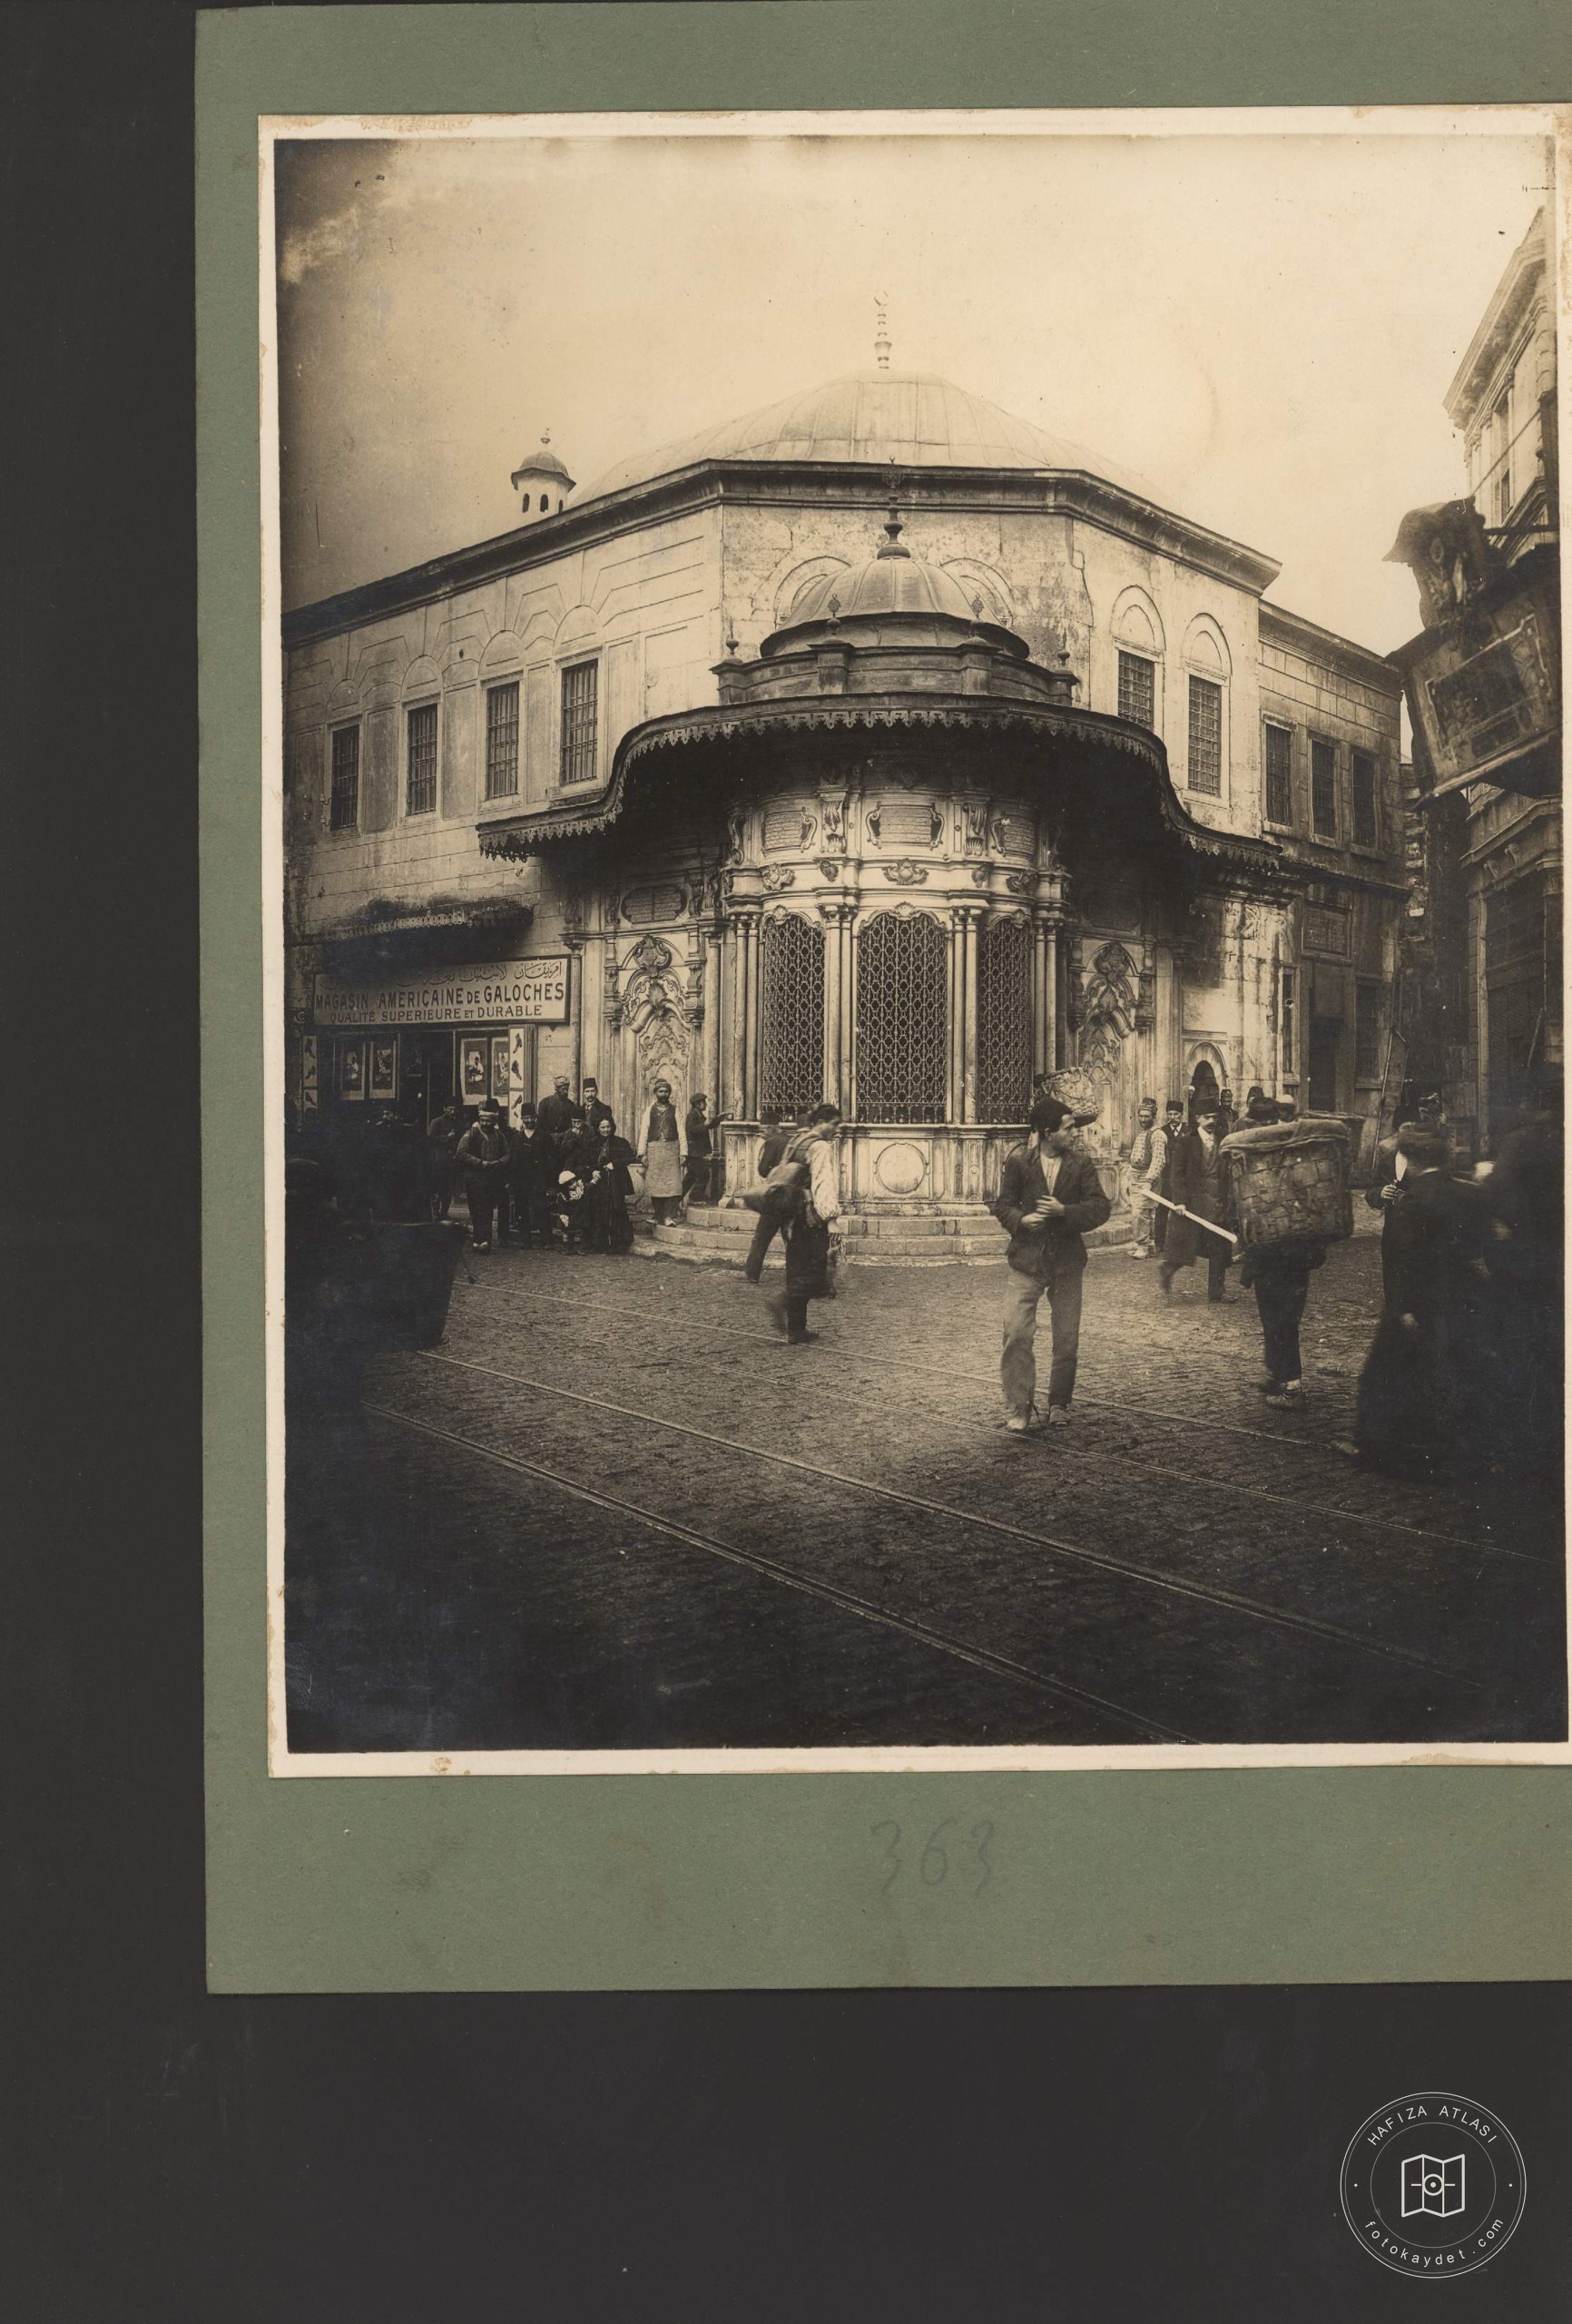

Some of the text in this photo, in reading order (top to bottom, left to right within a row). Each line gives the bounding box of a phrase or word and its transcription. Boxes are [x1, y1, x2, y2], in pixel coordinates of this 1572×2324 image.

[315, 983, 565, 1010] MAGASIN AMERICAINE DE GALOCHES
[464, 1009, 474, 1019] ET
[477, 1005, 542, 1018] DURABLE
